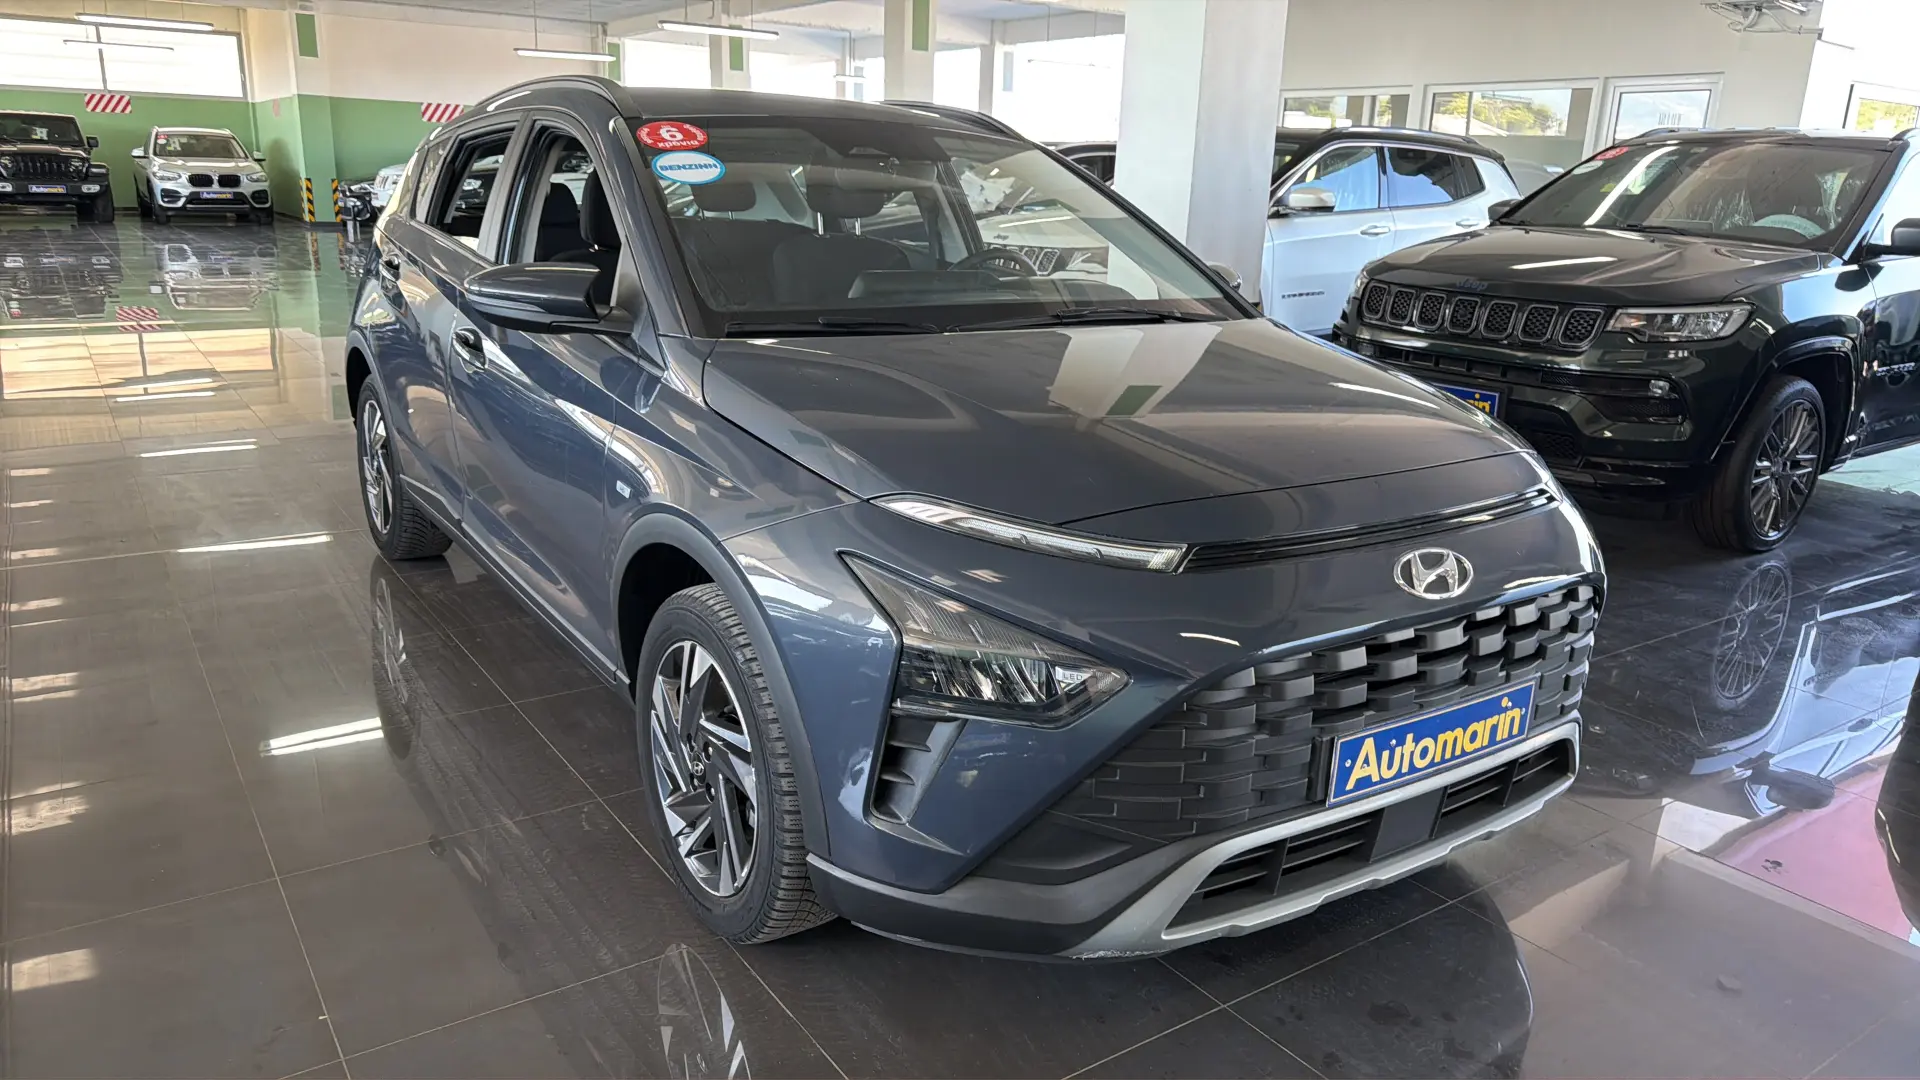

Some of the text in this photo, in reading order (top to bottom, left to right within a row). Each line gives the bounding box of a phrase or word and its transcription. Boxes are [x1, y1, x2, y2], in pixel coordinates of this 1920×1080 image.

[660, 127, 683, 141] 6
[1062, 671, 1083, 681] LED
[1345, 696, 1521, 791] Automarin
